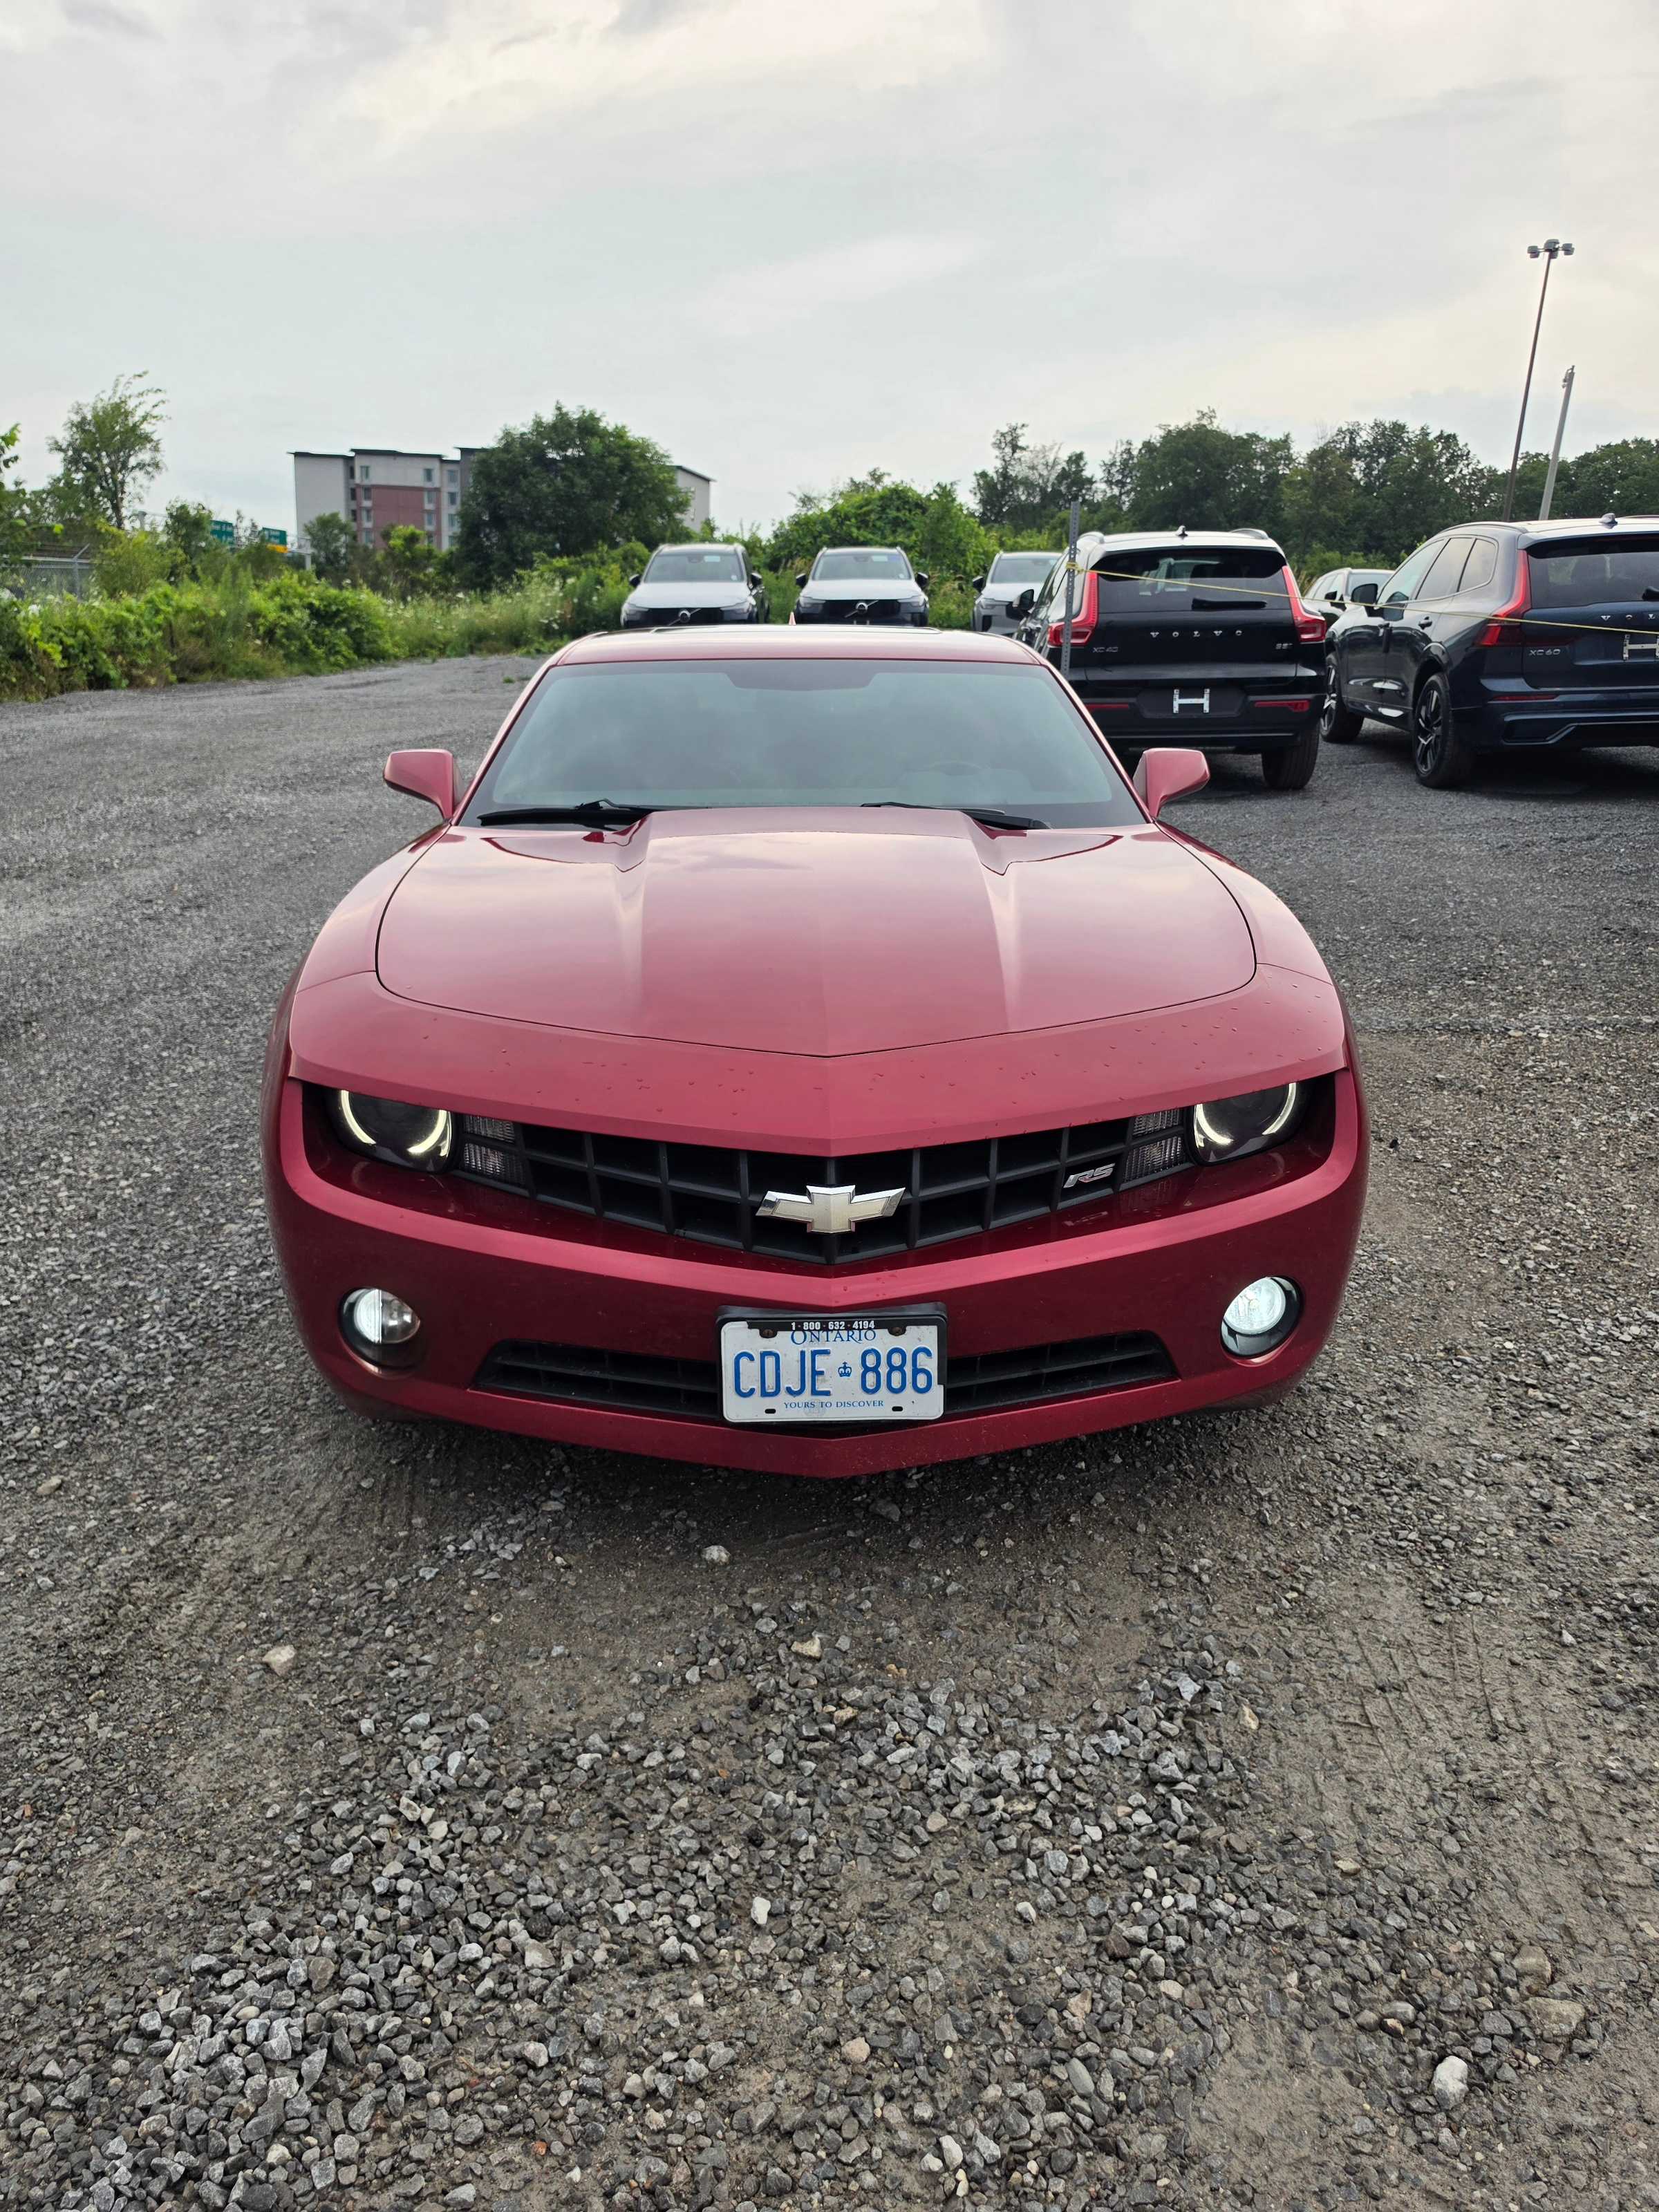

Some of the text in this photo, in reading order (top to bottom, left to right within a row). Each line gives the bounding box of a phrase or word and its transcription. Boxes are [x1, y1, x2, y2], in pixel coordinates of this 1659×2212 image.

[1063, 1163, 1116, 1188] RS
[790, 1329, 877, 1345] ONTARIO
[733, 1347, 933, 1398] CDJE 886
[836, 1400, 883, 1408] DISCOVER
